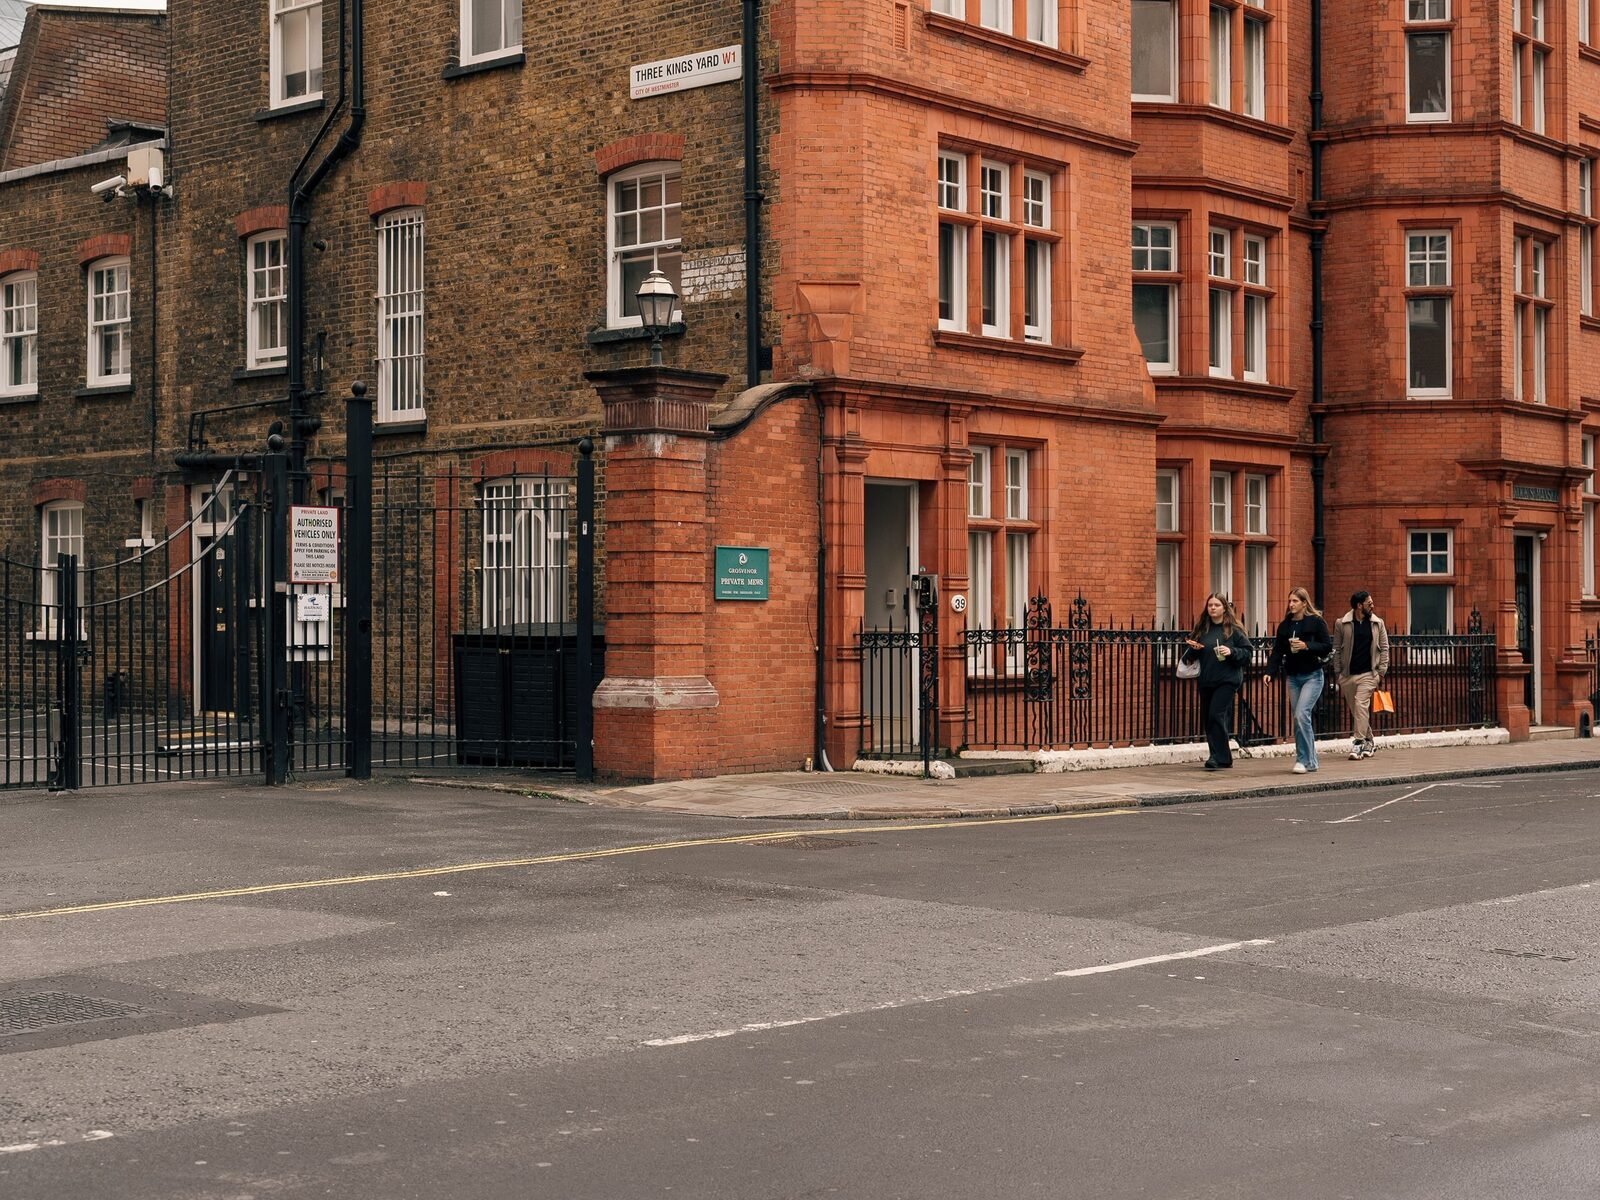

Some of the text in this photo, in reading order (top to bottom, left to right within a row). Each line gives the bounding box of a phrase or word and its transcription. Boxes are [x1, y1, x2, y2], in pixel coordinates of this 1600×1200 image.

[636, 51, 736, 81] THREE KINGS YARD W1
[651, 82, 679, 92] WESTMINSTER
[297, 518, 332, 527] AUTHORISED
[294, 529, 336, 539] VEHICLES ONLY
[955, 598, 965, 609] 39
